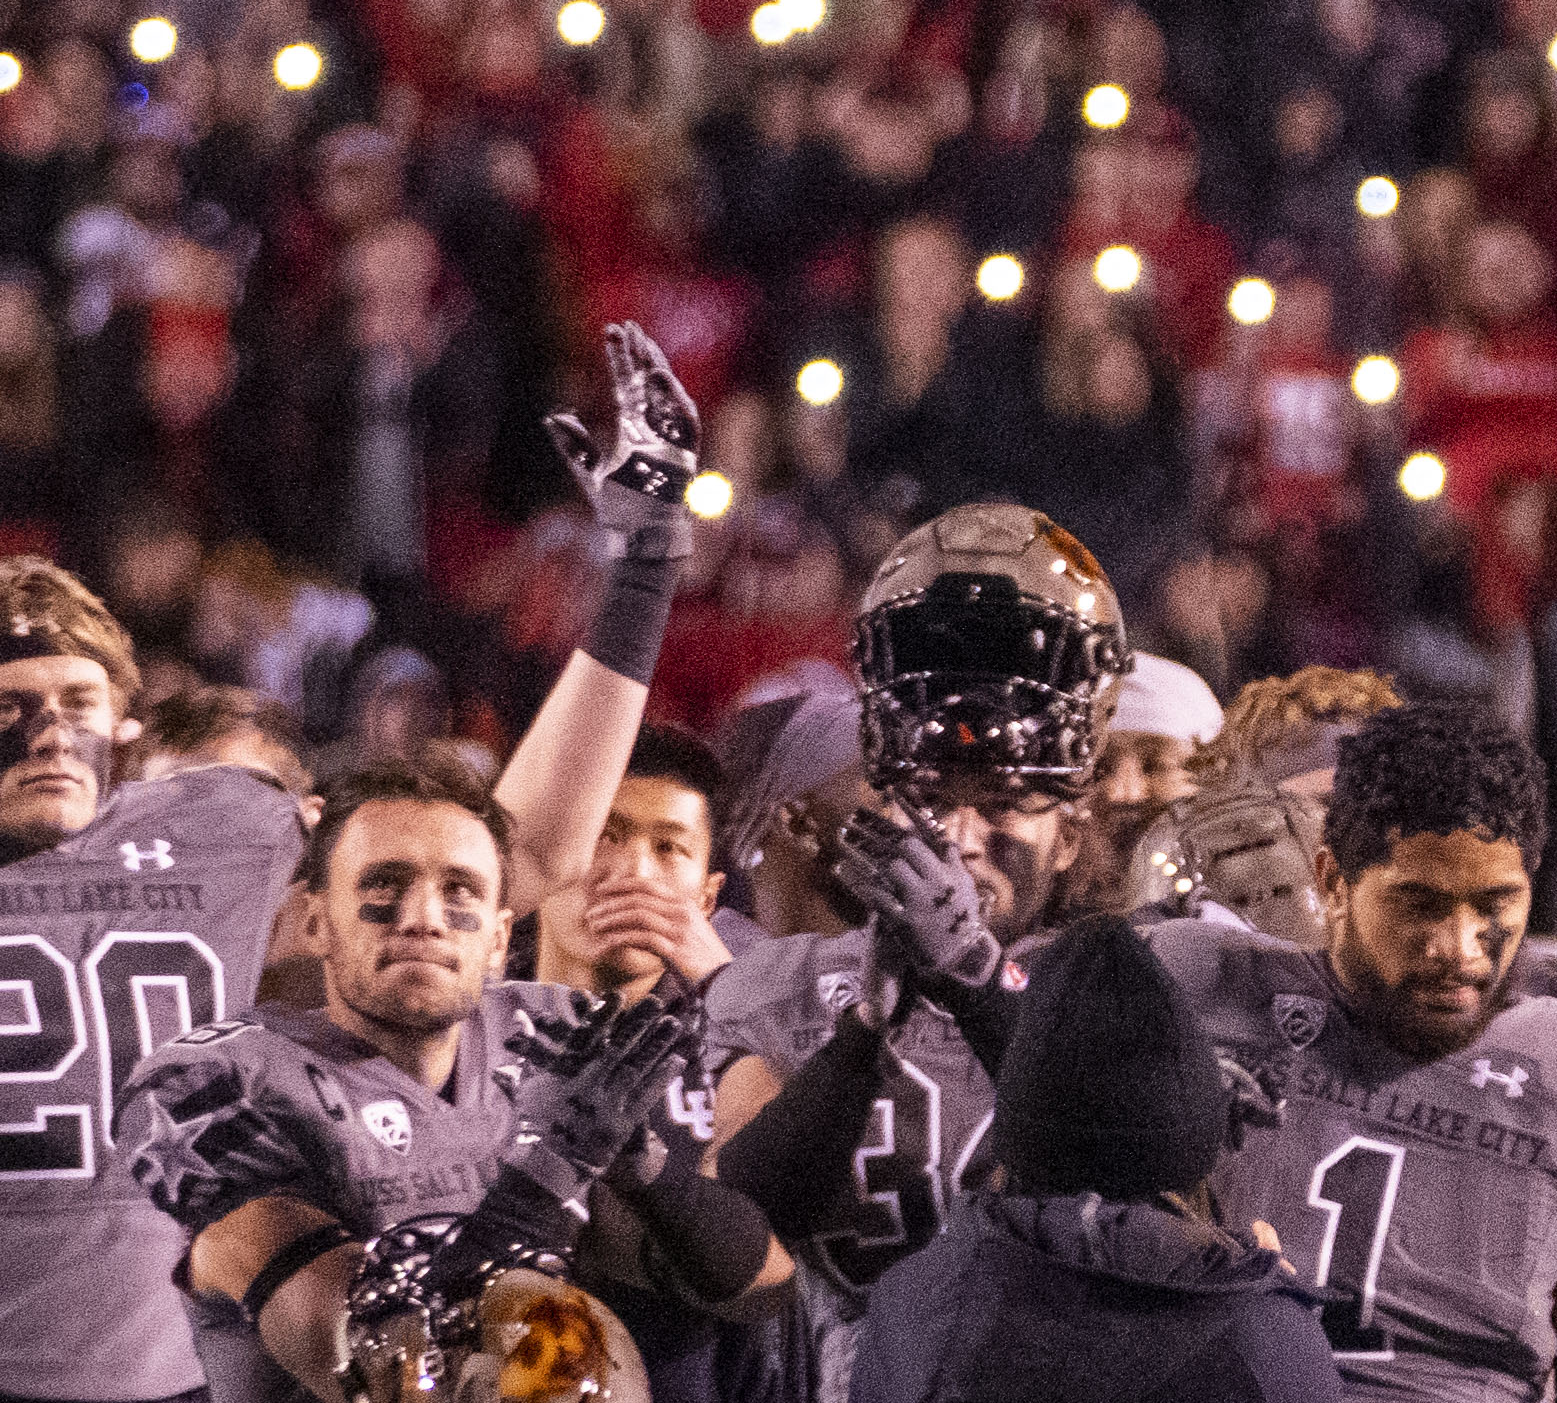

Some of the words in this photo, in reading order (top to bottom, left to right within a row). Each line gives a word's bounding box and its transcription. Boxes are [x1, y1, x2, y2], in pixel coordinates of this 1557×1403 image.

[61, 882, 133, 913] LAKE
[142, 883, 205, 911] CITY
[1299, 1063, 1380, 1113] SALT
[1385, 1094, 1467, 1142] LAKE
[1475, 1117, 1549, 1166] CITY
[1304, 1132, 1406, 1363] 1
